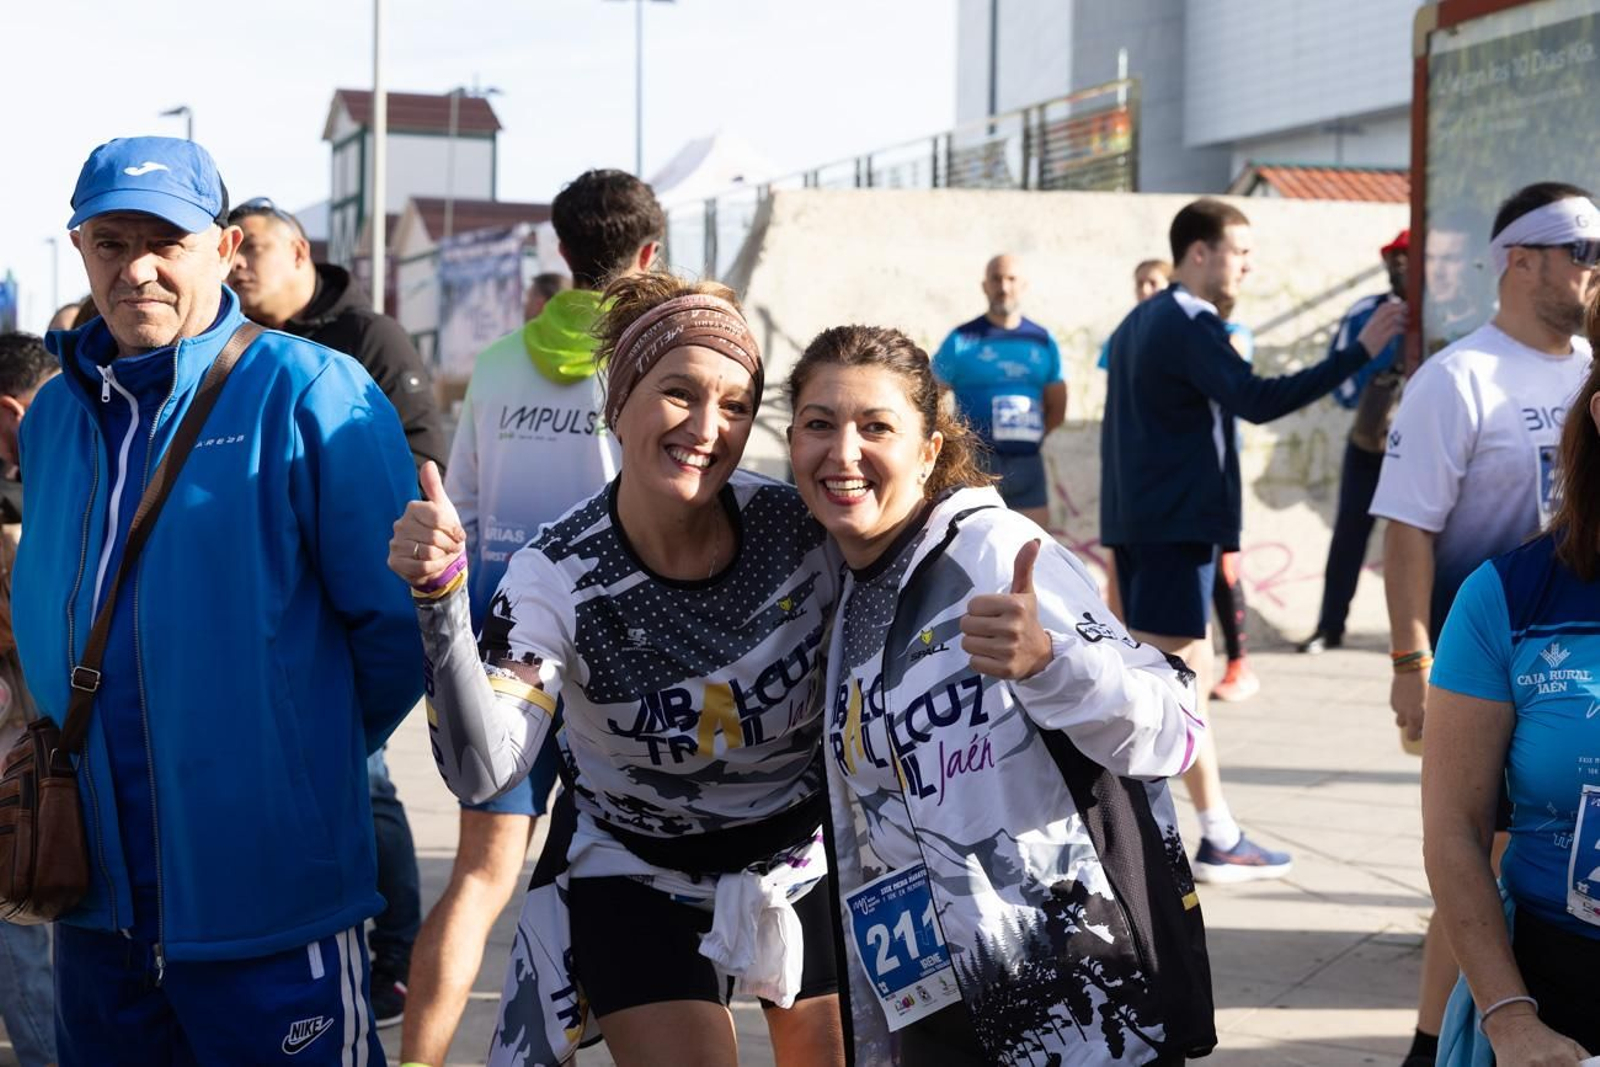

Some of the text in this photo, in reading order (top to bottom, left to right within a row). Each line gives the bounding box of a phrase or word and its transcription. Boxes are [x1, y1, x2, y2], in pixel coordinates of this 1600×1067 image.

[1517, 669, 1593, 686] CAJA RURAL
[1538, 680, 1567, 695] JAÉN
[886, 674, 989, 758] LCUZ
[937, 734, 995, 806] Jaén
[290, 1019, 322, 1041] NIKE
